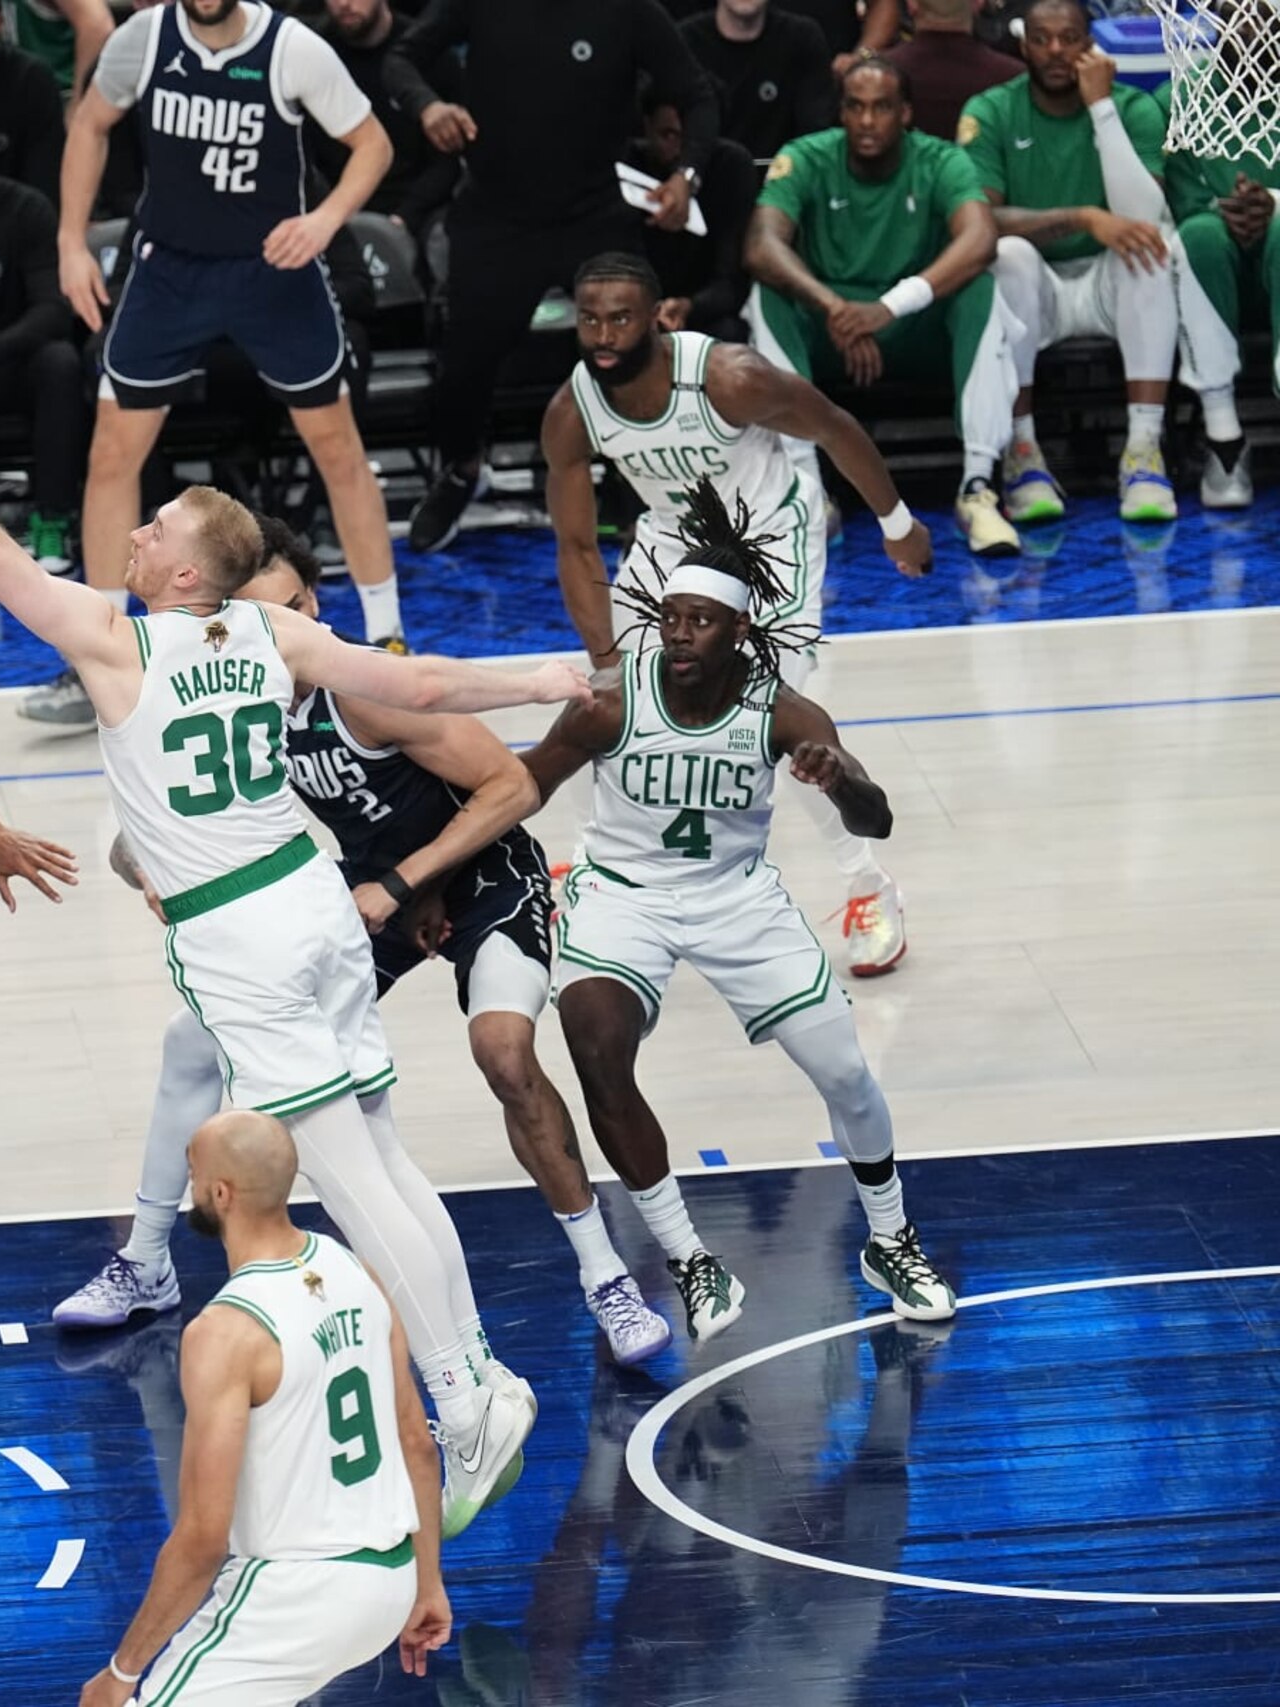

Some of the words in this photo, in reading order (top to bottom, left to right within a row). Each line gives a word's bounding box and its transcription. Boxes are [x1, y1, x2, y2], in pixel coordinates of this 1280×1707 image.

[201, 145, 259, 193] 42
[620, 445, 730, 481] ELTICS
[170, 659, 266, 706] HAUSER
[162, 700, 286, 818] 30
[727, 742, 756, 751] PRINT
[728, 728, 756, 741] VISTA
[622, 752, 755, 811] CELTICS
[661, 807, 712, 860] 4
[311, 1308, 363, 1362] WHITE
[326, 1365, 382, 1487] 9
